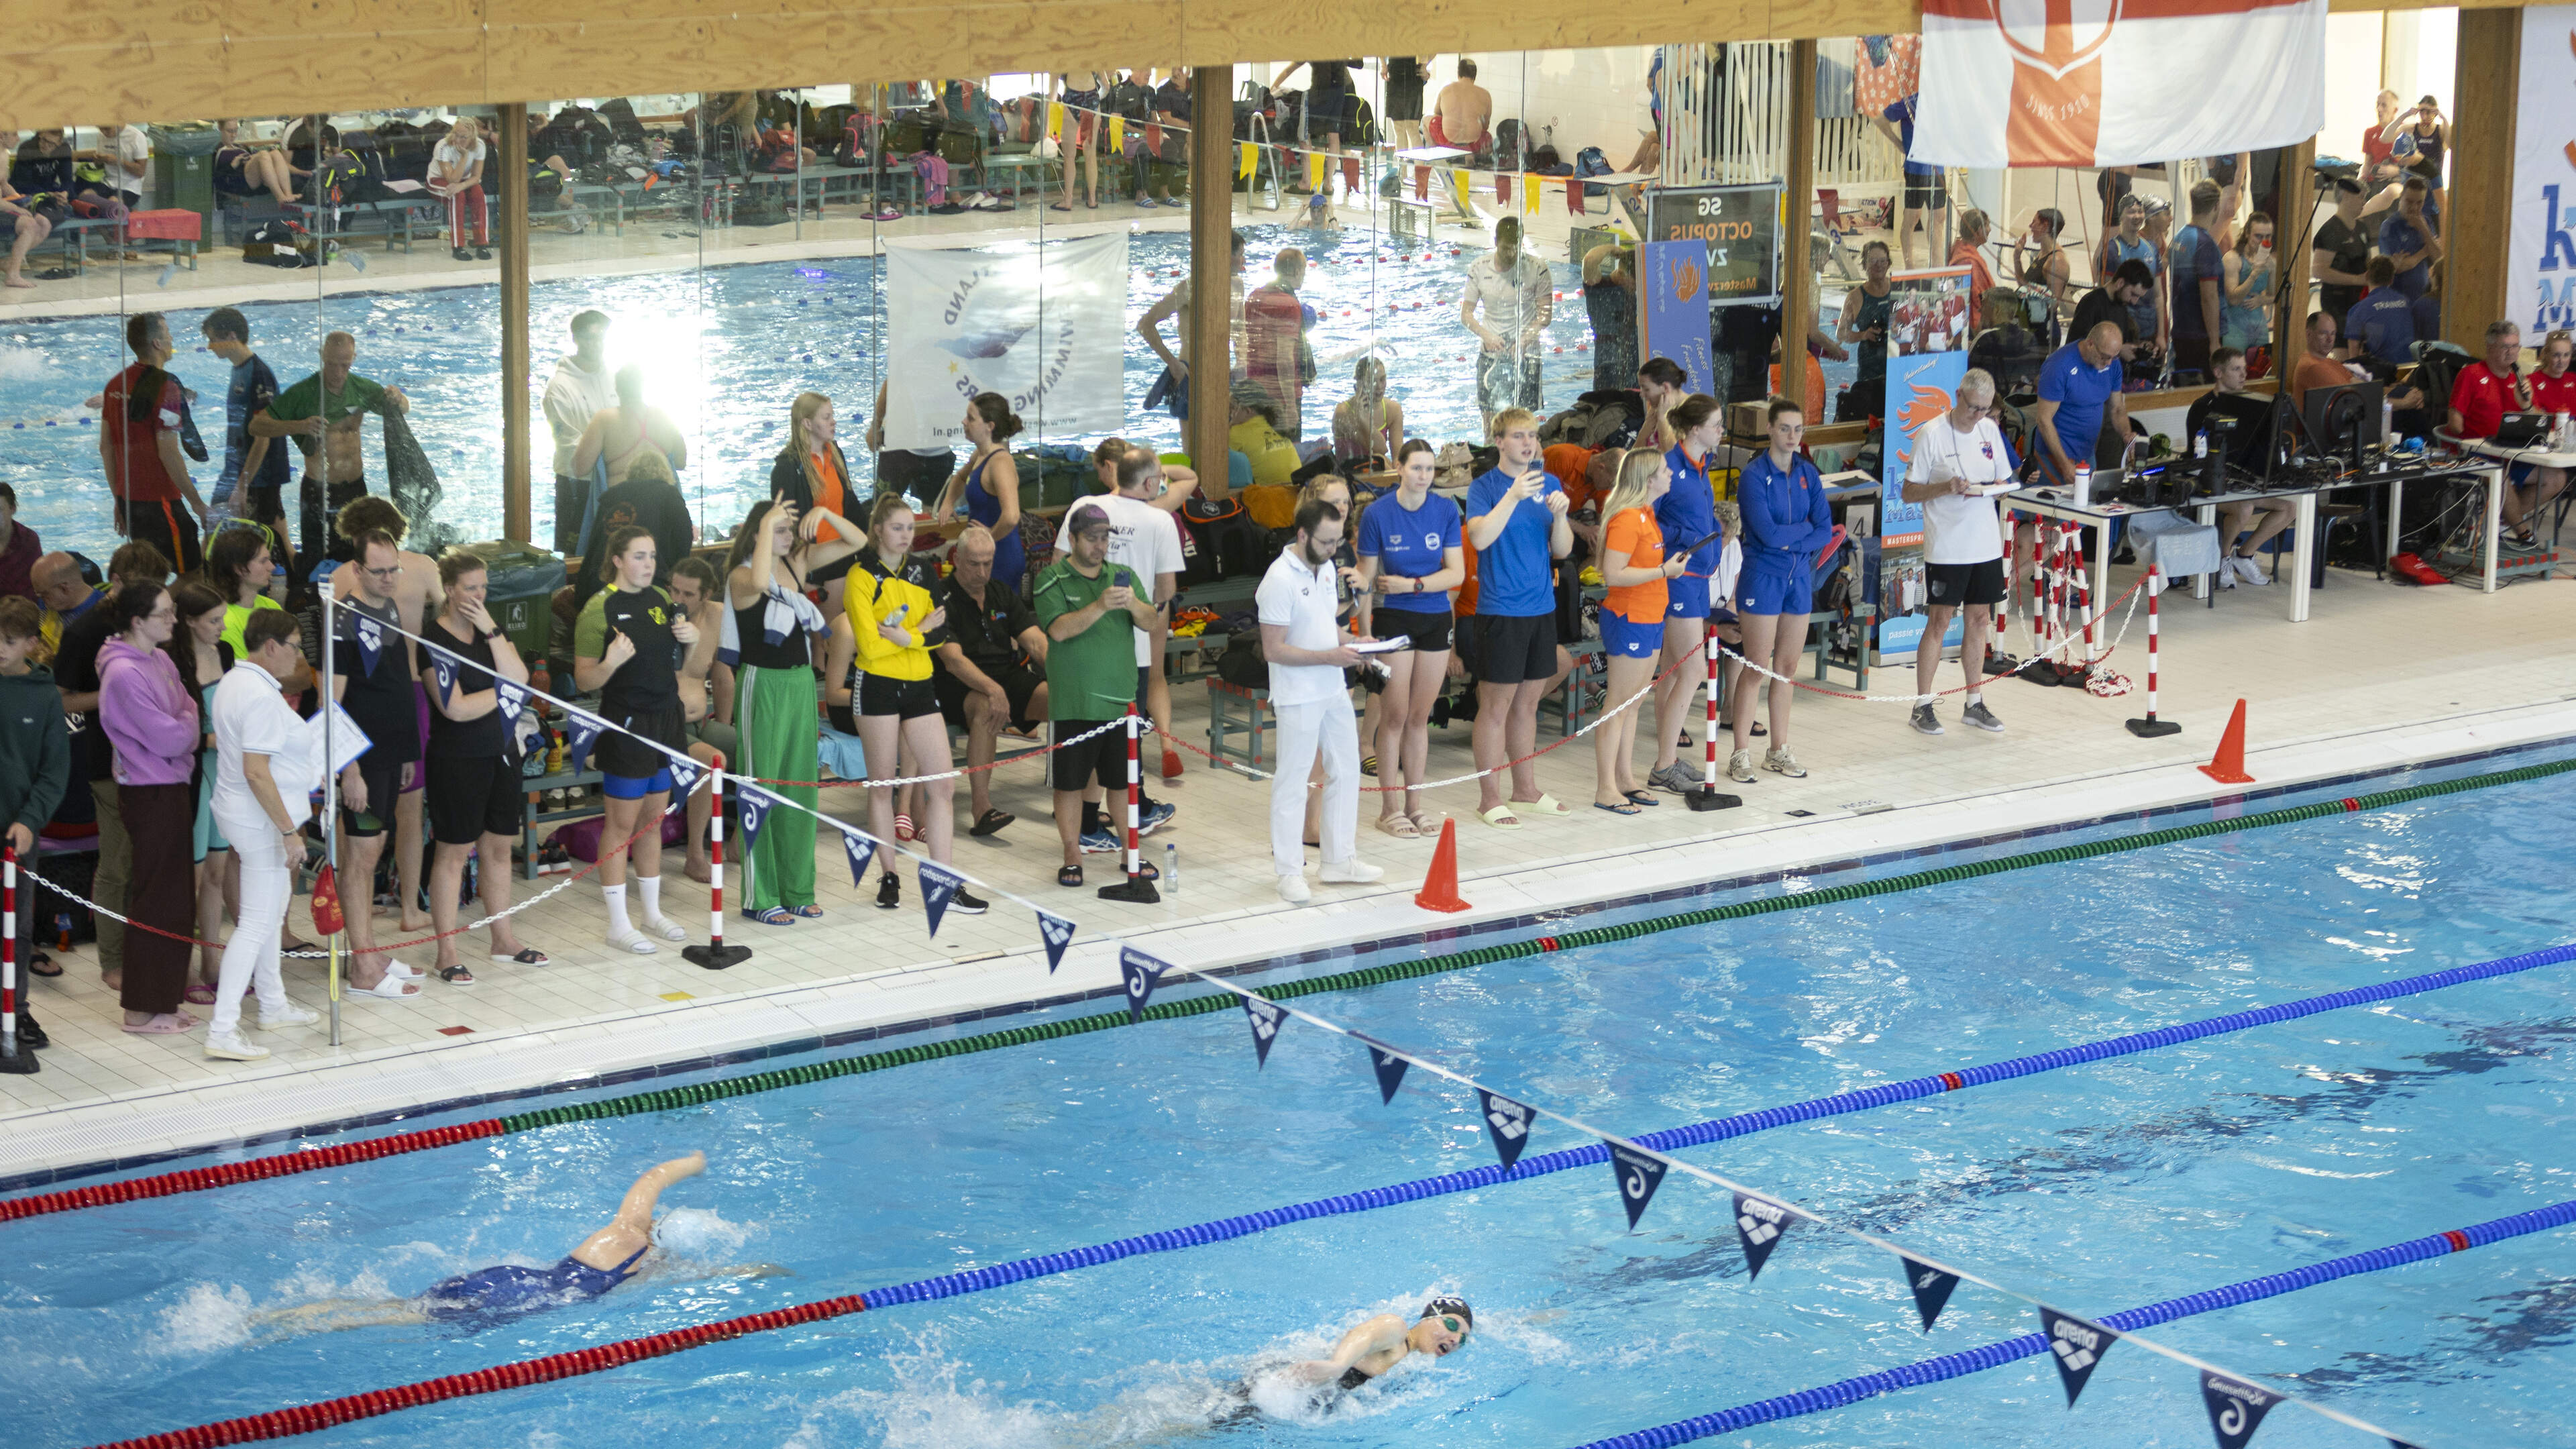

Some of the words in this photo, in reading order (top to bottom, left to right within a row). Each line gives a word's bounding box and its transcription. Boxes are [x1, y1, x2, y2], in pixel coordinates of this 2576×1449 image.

[2061, 93, 2090, 121] 1910
[1888, 628, 1914, 641] passie
[500, 683, 524, 704] arena
[919, 867, 959, 890] robsport.nl
[1248, 997, 1277, 1023] arena
[1489, 1094, 1526, 1120] arena
[1741, 1199, 1785, 1224] arena
[2054, 1320, 2098, 1350] arena
